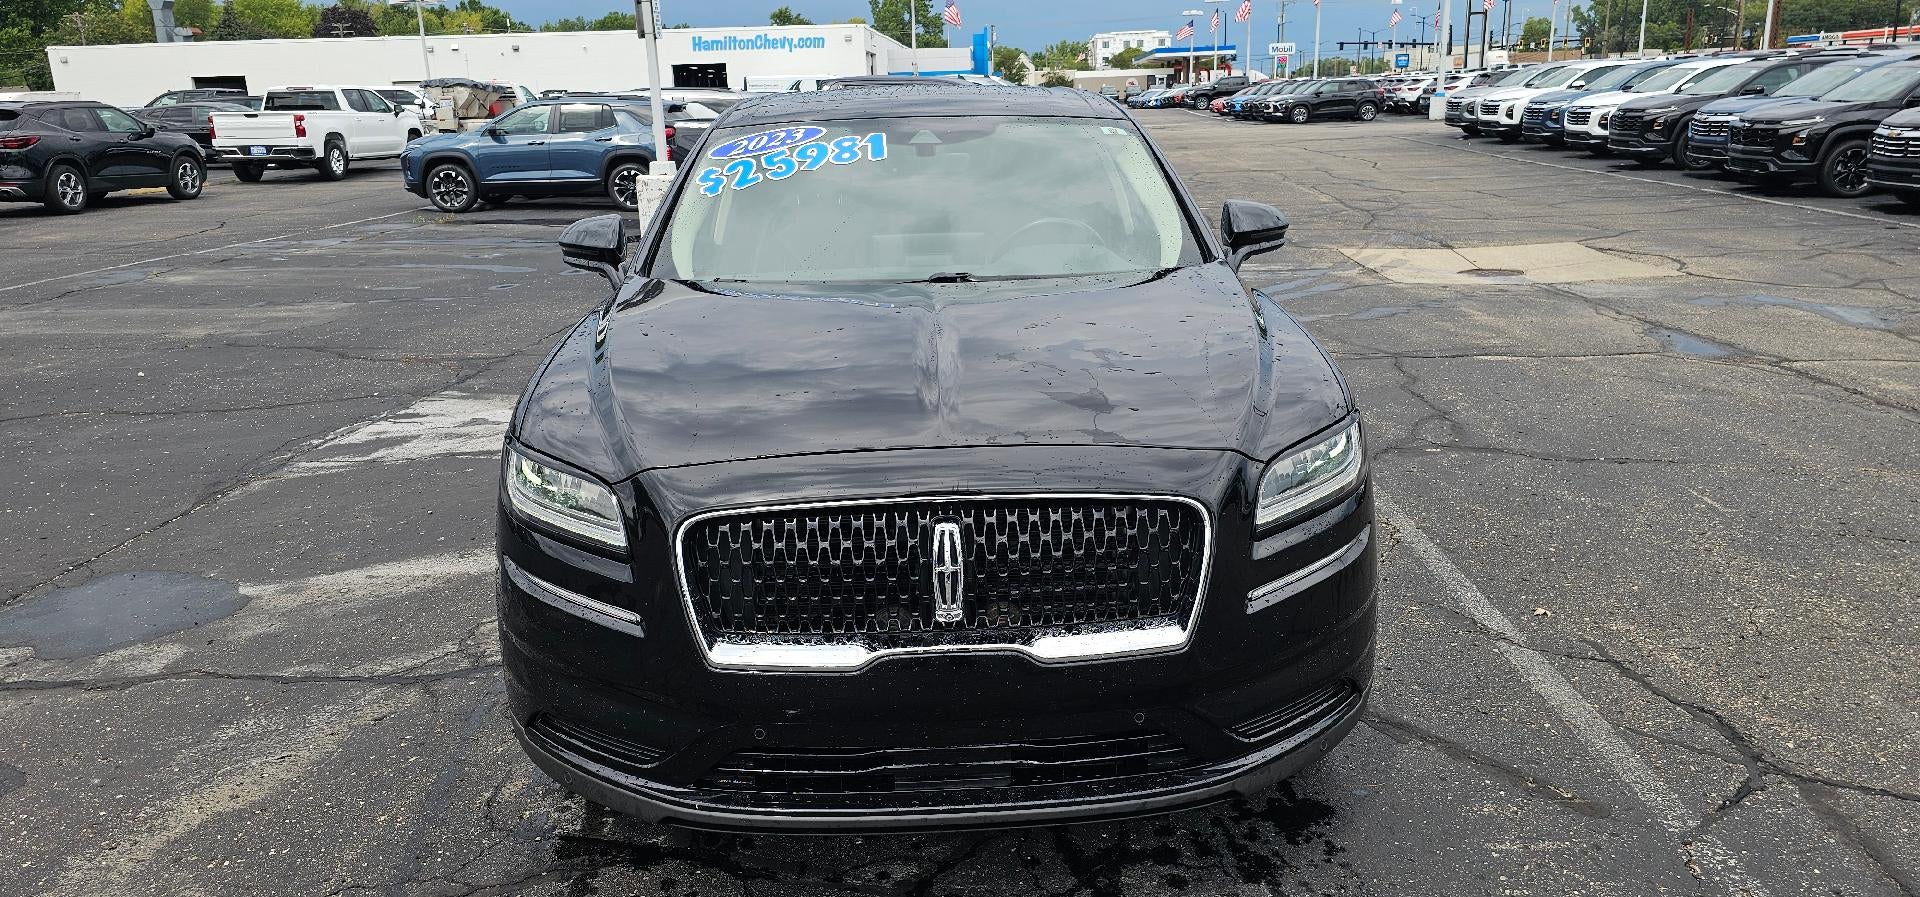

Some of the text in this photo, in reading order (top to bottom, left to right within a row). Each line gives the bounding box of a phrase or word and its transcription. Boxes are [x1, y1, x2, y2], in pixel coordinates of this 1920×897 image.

[692, 34, 825, 52] HamiltonChevy.com
[1271, 45, 1293, 53] Mobil
[726, 128, 806, 157] 2023
[696, 132, 888, 197] $25981
